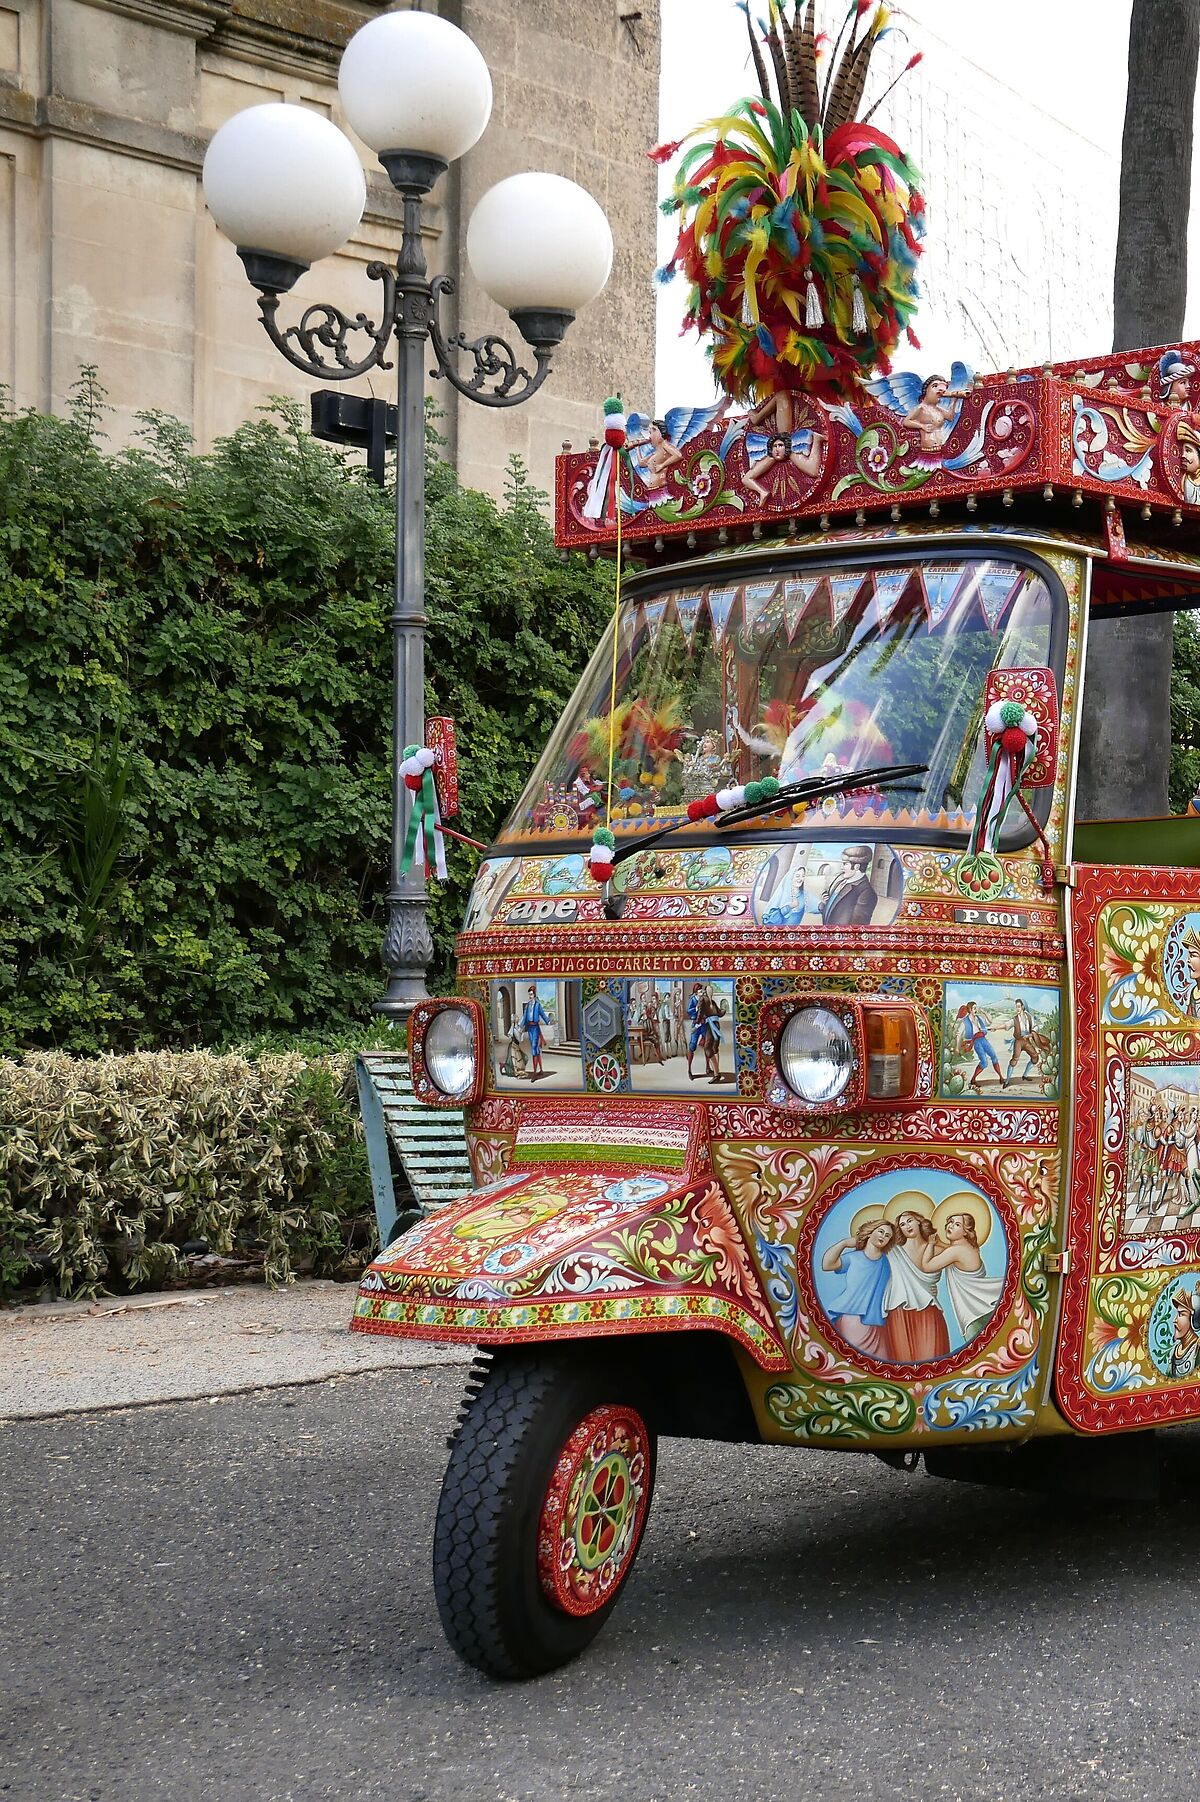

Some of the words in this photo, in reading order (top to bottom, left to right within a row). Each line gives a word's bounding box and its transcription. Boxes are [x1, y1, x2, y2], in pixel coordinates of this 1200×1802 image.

[876, 567, 912, 577] SICILIA
[510, 898, 576, 923] ape
[962, 909, 979, 923] P
[986, 911, 1021, 928] 601
[515, 957, 546, 971] APE
[552, 957, 609, 971] PIAGGIO
[615, 956, 694, 971] CARRETTO
[405, 1295, 435, 1305] DECORATA
